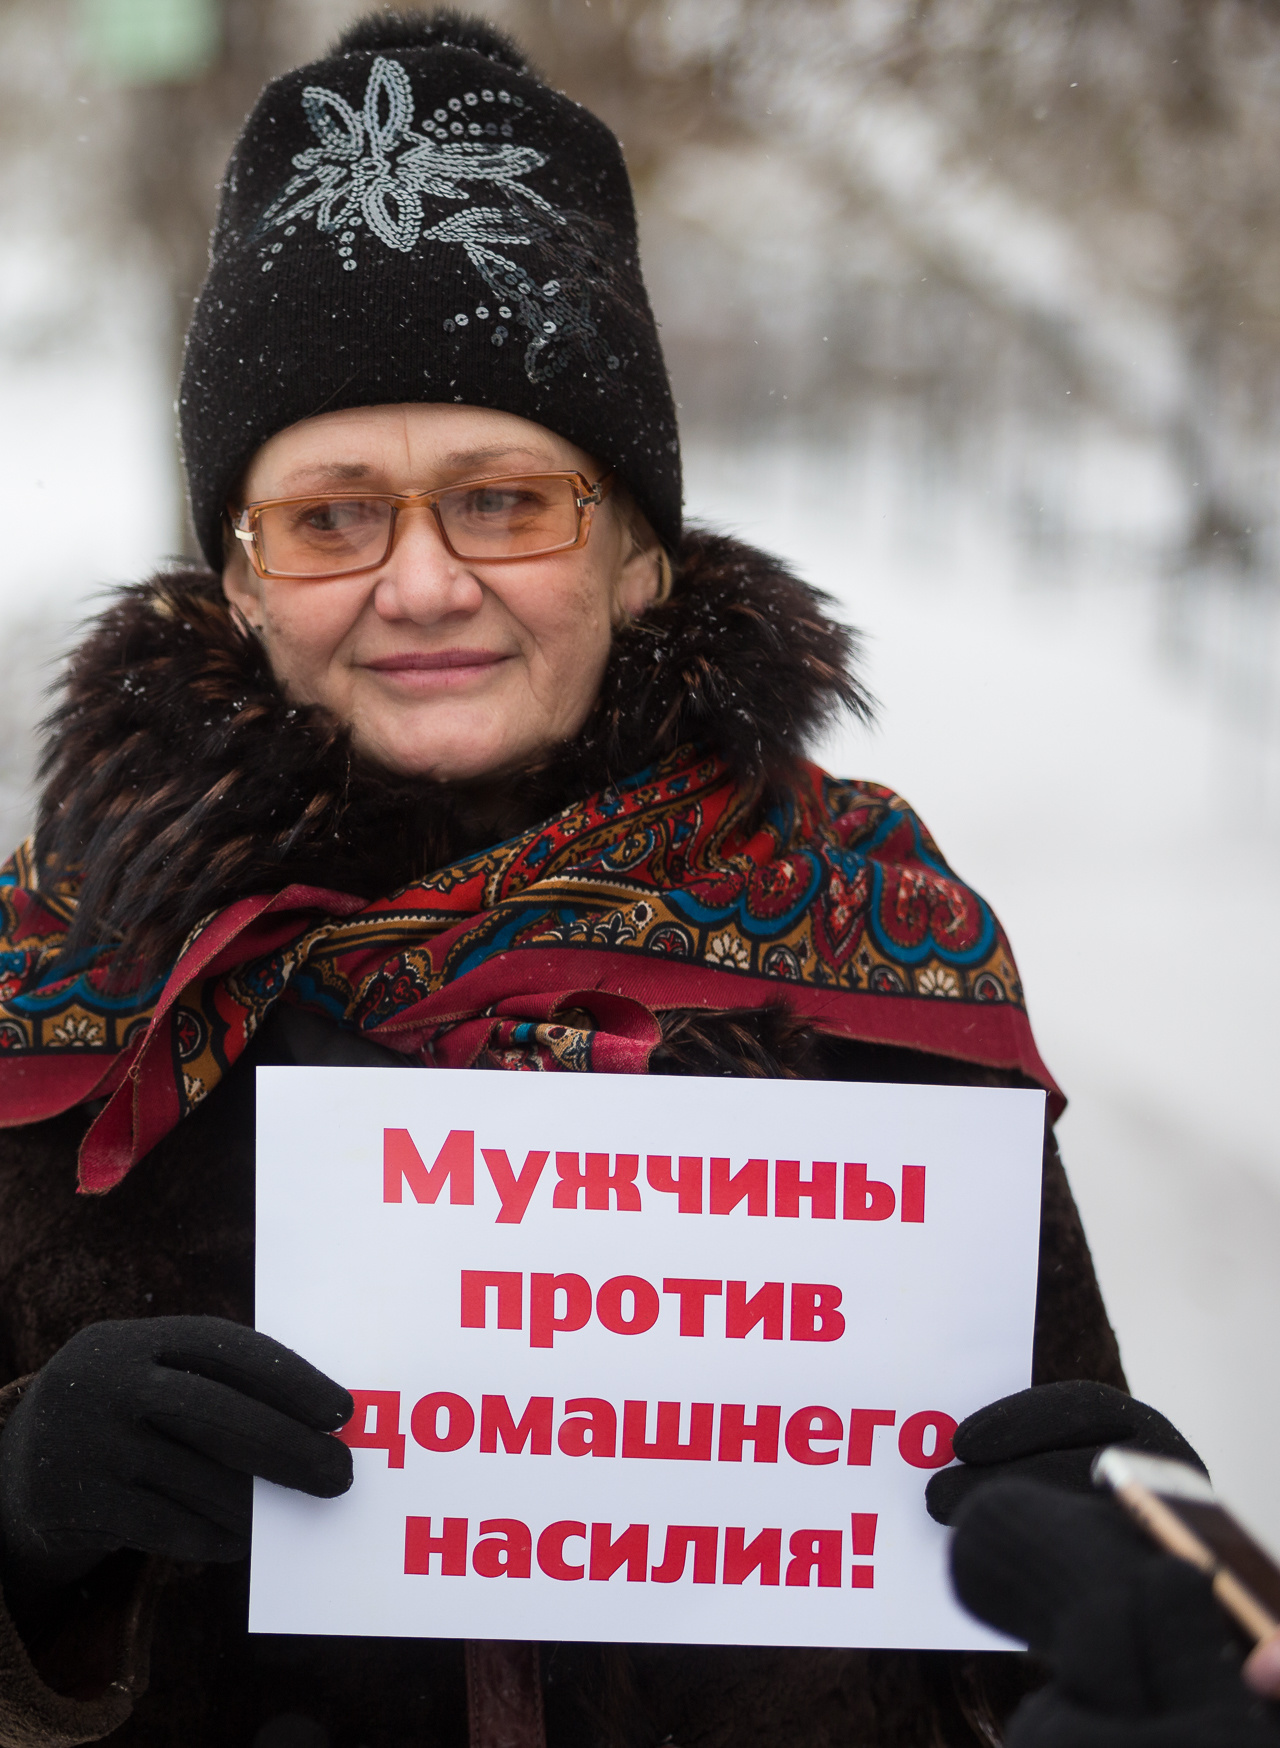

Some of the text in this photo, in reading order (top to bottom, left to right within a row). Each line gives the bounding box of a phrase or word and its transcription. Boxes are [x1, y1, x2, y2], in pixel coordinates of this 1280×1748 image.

[383, 1127, 926, 1225] Мужчины
[460, 1269, 846, 1349] против
[332, 1388, 959, 1470] домашнего
[403, 1512, 879, 1589] насилия!
